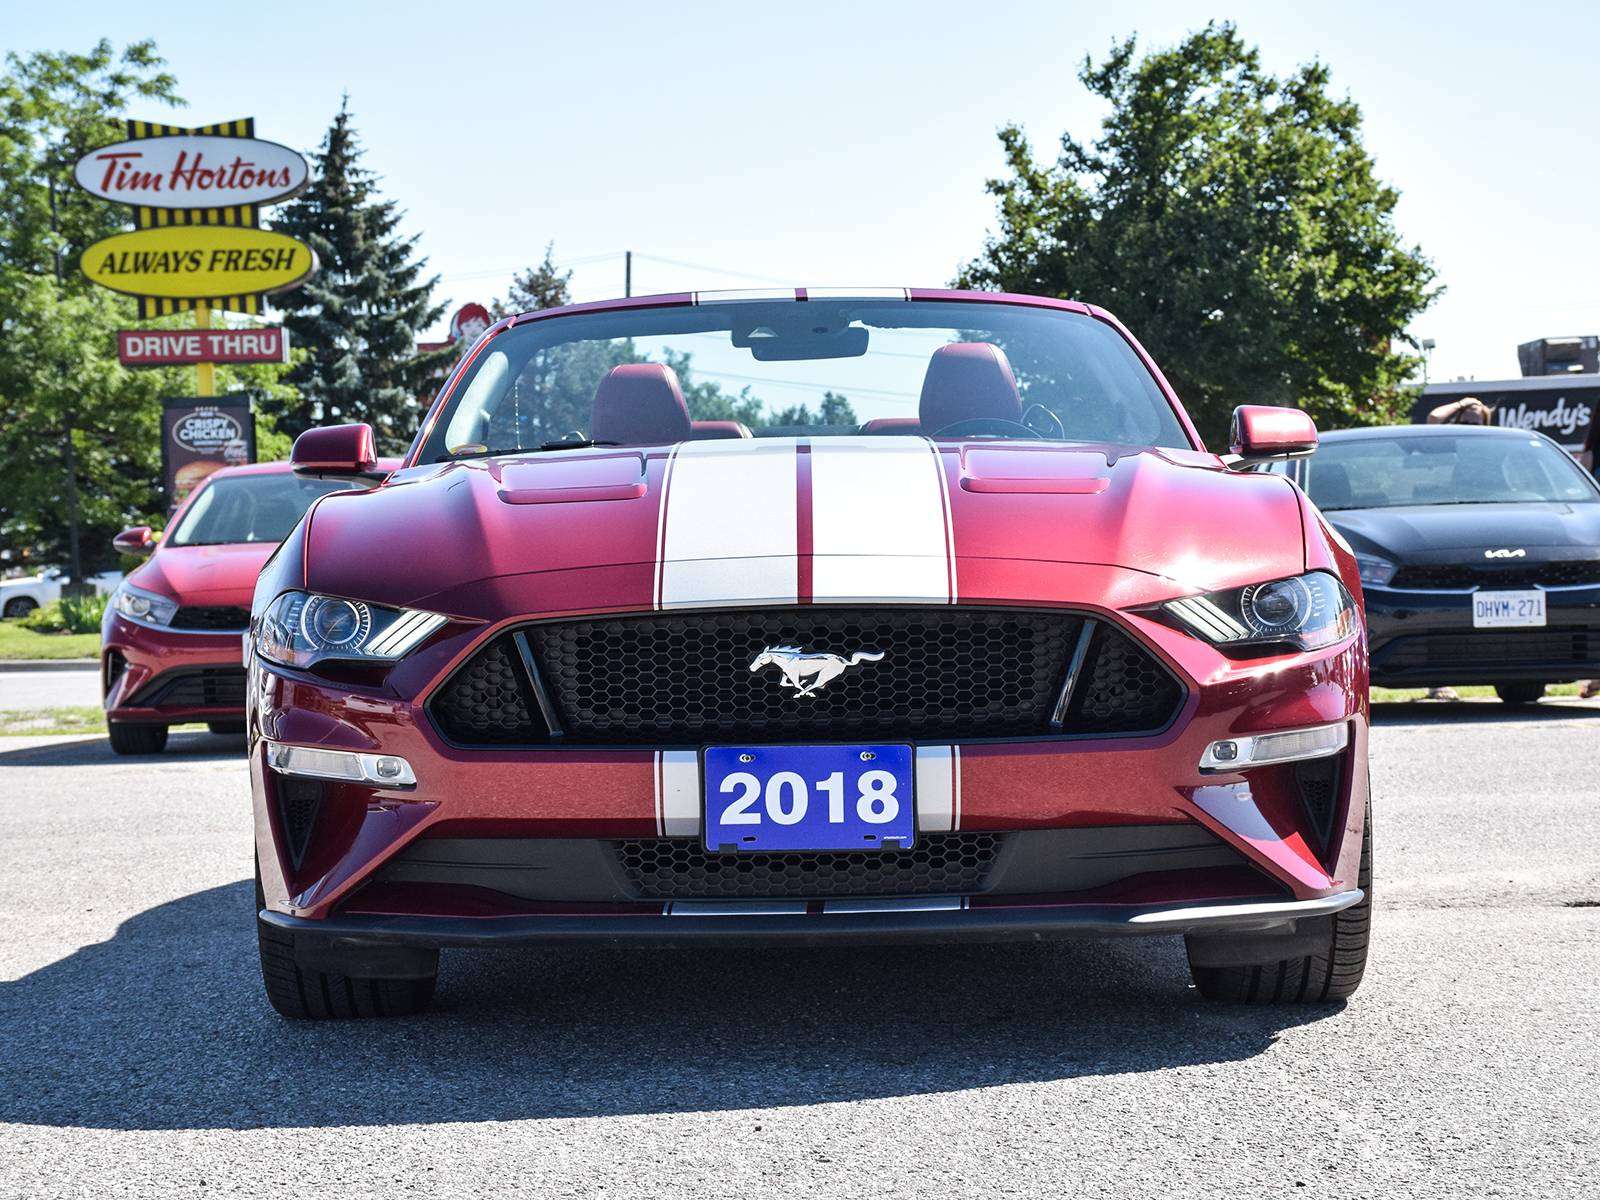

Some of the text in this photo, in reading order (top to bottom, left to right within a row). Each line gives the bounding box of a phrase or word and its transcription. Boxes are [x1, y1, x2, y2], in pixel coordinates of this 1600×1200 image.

[96, 150, 291, 193] Tim Hortons
[98, 248, 296, 274] ALWAYS FRESH
[126, 334, 277, 357] DRIVE THRU
[185, 418, 229, 430] CRISPY
[1498, 397, 1592, 435] Wendy's
[179, 428, 236, 440] CHICKEN
[719, 769, 900, 825] 2018
